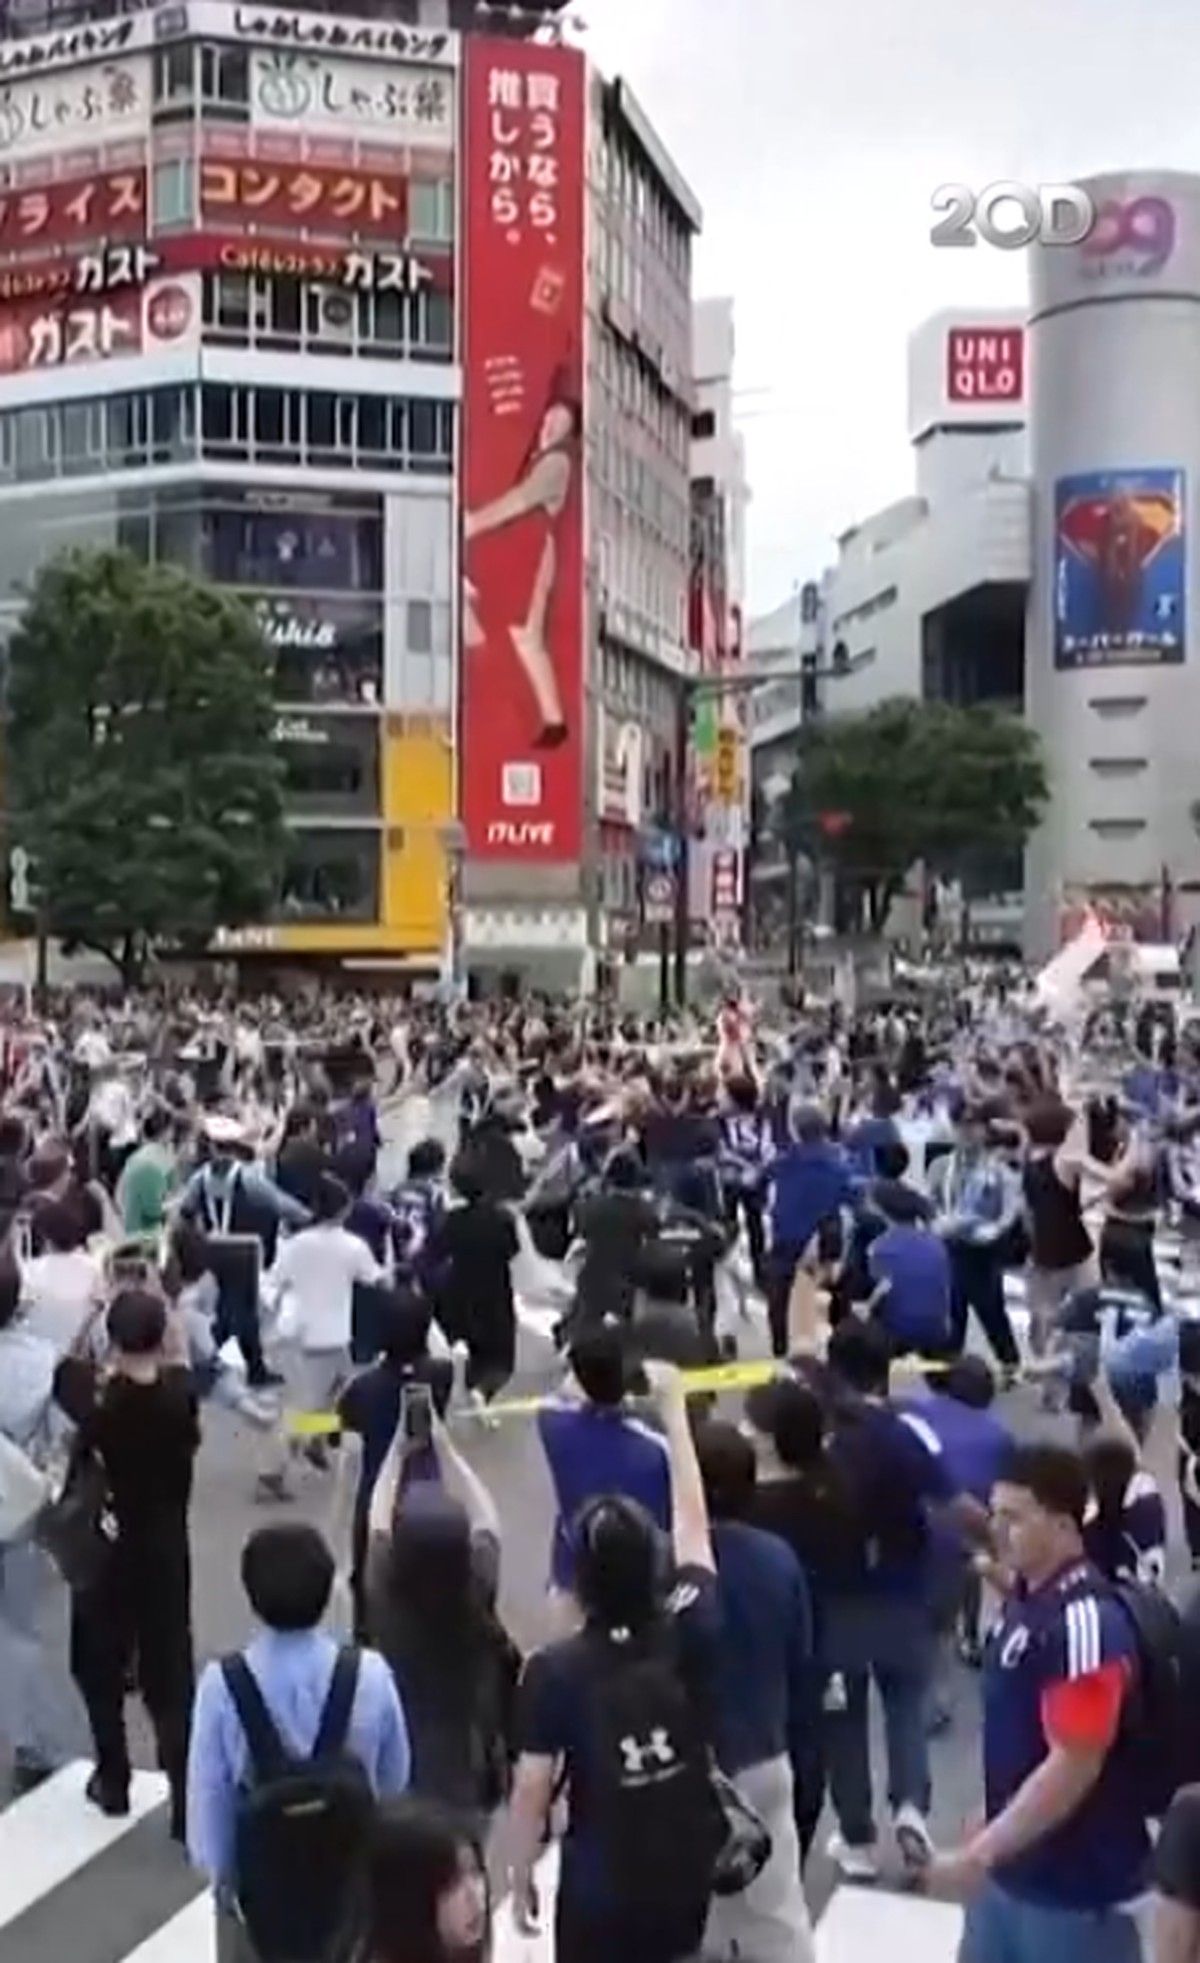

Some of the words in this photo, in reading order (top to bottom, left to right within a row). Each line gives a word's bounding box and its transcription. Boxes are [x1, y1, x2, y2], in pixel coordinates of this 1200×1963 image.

[489, 68, 521, 246] 推しから。
[526, 72, 559, 245] 買うなら、
[203, 166, 399, 221] コンタクト
[954, 337, 1011, 363] UNI
[954, 368, 1016, 396] QLO
